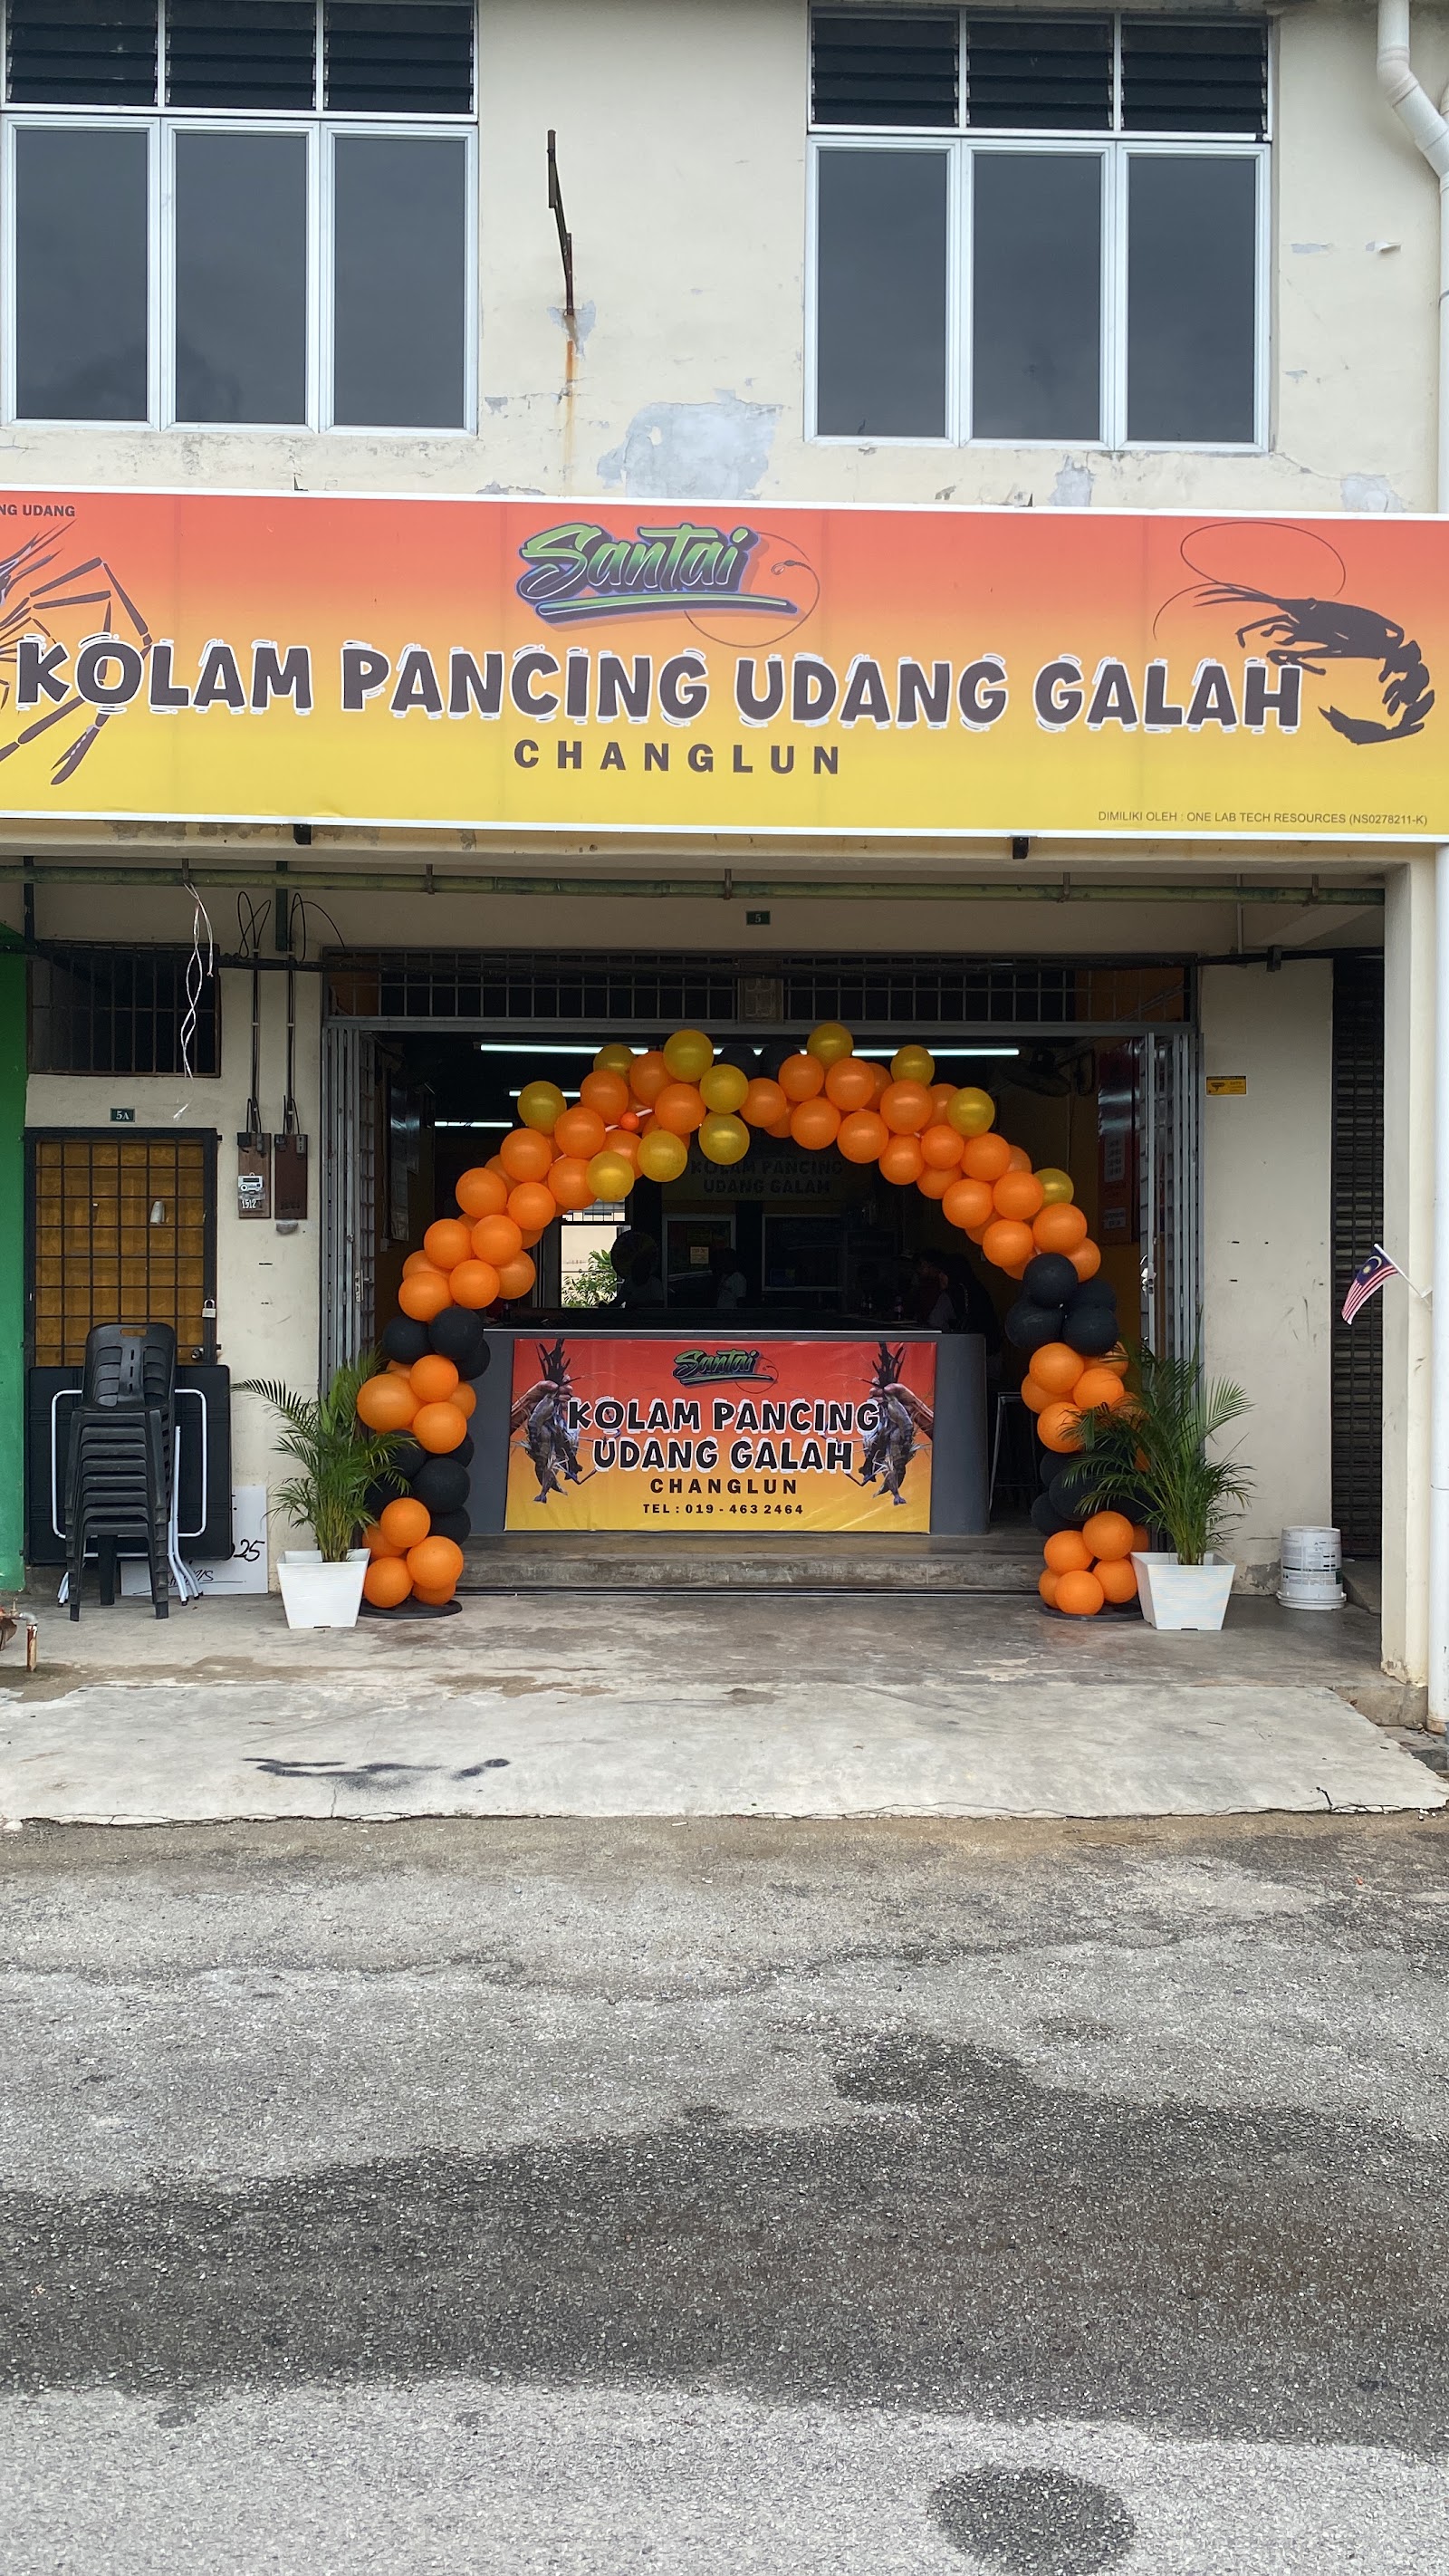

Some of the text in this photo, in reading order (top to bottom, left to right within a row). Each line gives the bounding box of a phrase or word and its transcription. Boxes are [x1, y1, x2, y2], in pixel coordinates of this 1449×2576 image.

[23, 505, 75, 516] UDANG
[516, 523, 759, 607] Santai
[17, 638, 1303, 729] KOLAM PANCING UDANG GALAH
[513, 738, 840, 775] CHANGLUN
[1098, 811, 1143, 822] DIMILIKI
[1146, 812, 1177, 822] OLEH
[1186, 812, 1212, 822] ONE
[1214, 812, 1237, 822] LAB
[1240, 812, 1271, 822] TECH
[1273, 813, 1347, 823] RESOURCES
[1348, 814, 1428, 826] (NS0278211-K)
[754, 913, 762, 923] 5
[115, 1110, 130, 1120] 5A
[672, 1349, 759, 1380] Santai
[567, 1399, 880, 1433] KOLAM PANCING
[592, 1439, 853, 1472] UDANG GALAH
[650, 1478, 797, 1495] CHANGLUN
[685, 1504, 714, 1514] 019
[729, 1504, 758, 1514] 463
[763, 1504, 803, 1514] 2464
